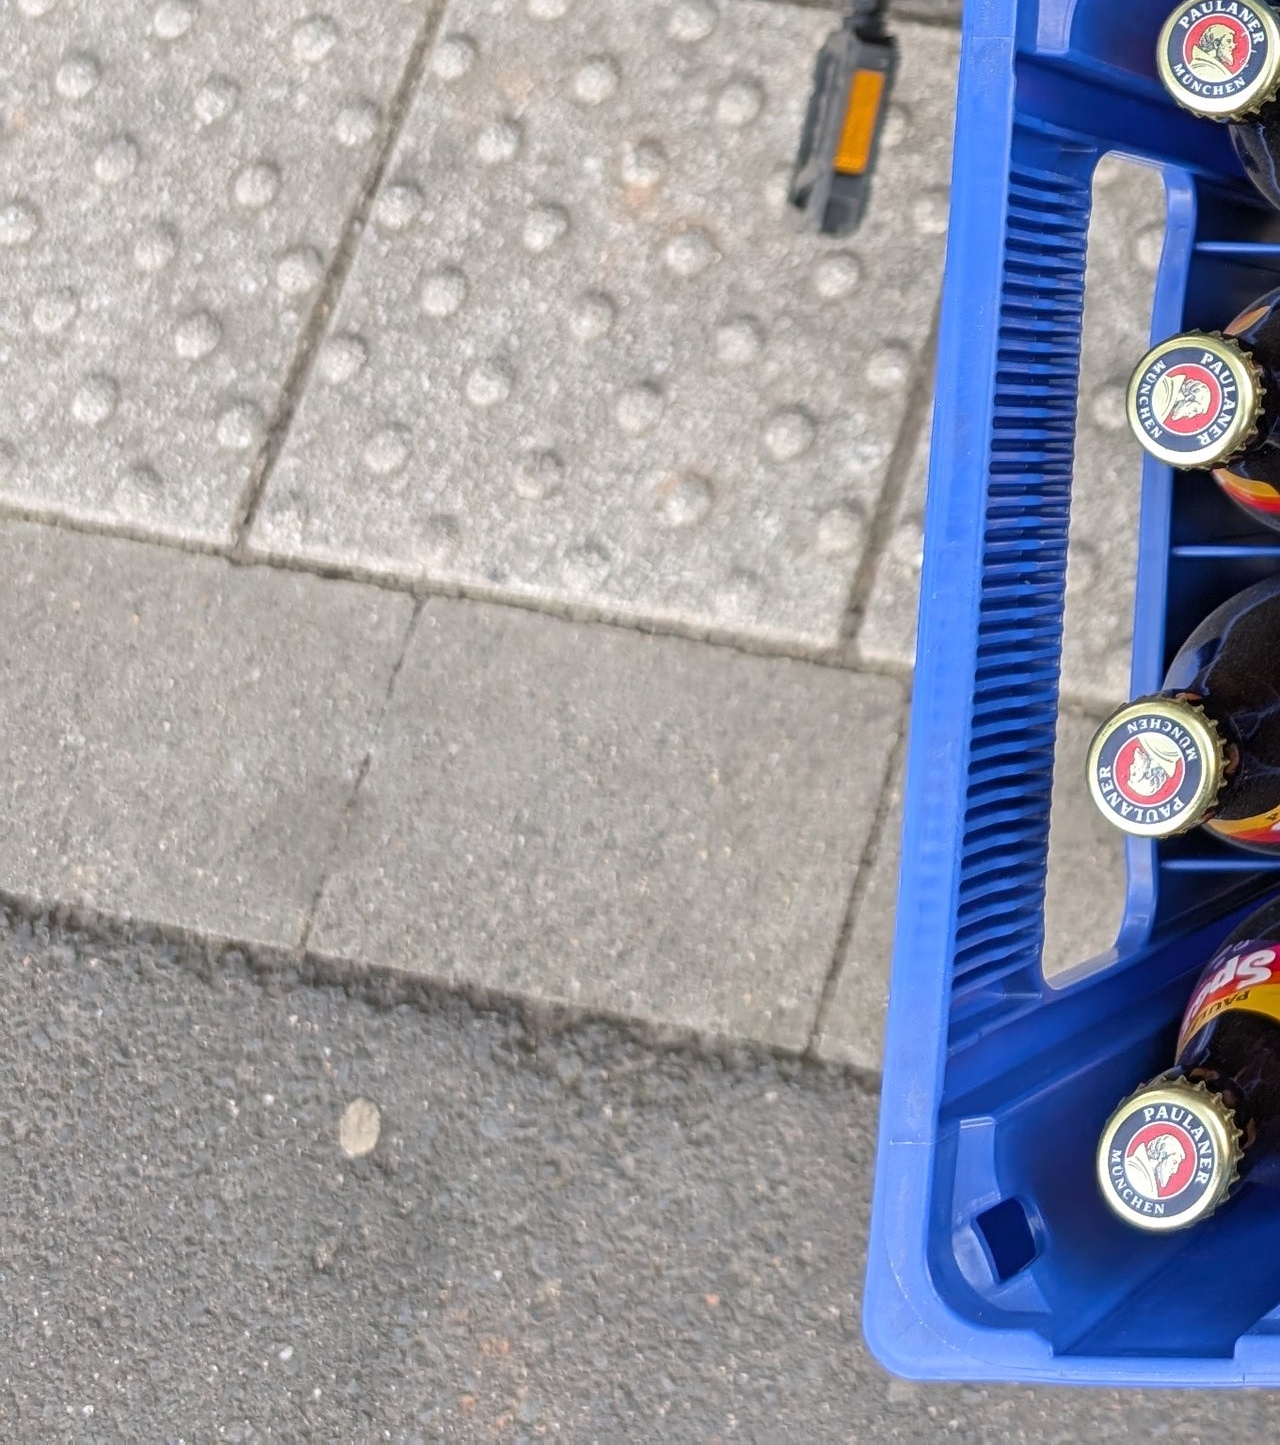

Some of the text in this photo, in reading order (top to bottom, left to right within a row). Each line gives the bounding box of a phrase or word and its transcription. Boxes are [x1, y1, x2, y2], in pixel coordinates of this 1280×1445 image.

[1178, 0, 1265, 45] PAULANER
[1173, 62, 1247, 96] MÜNCHEN
[1195, 351, 1237, 448] PAULANER
[1098, 764, 1185, 823] PAULANER
[1142, 1105, 1213, 1185] PAULANER
